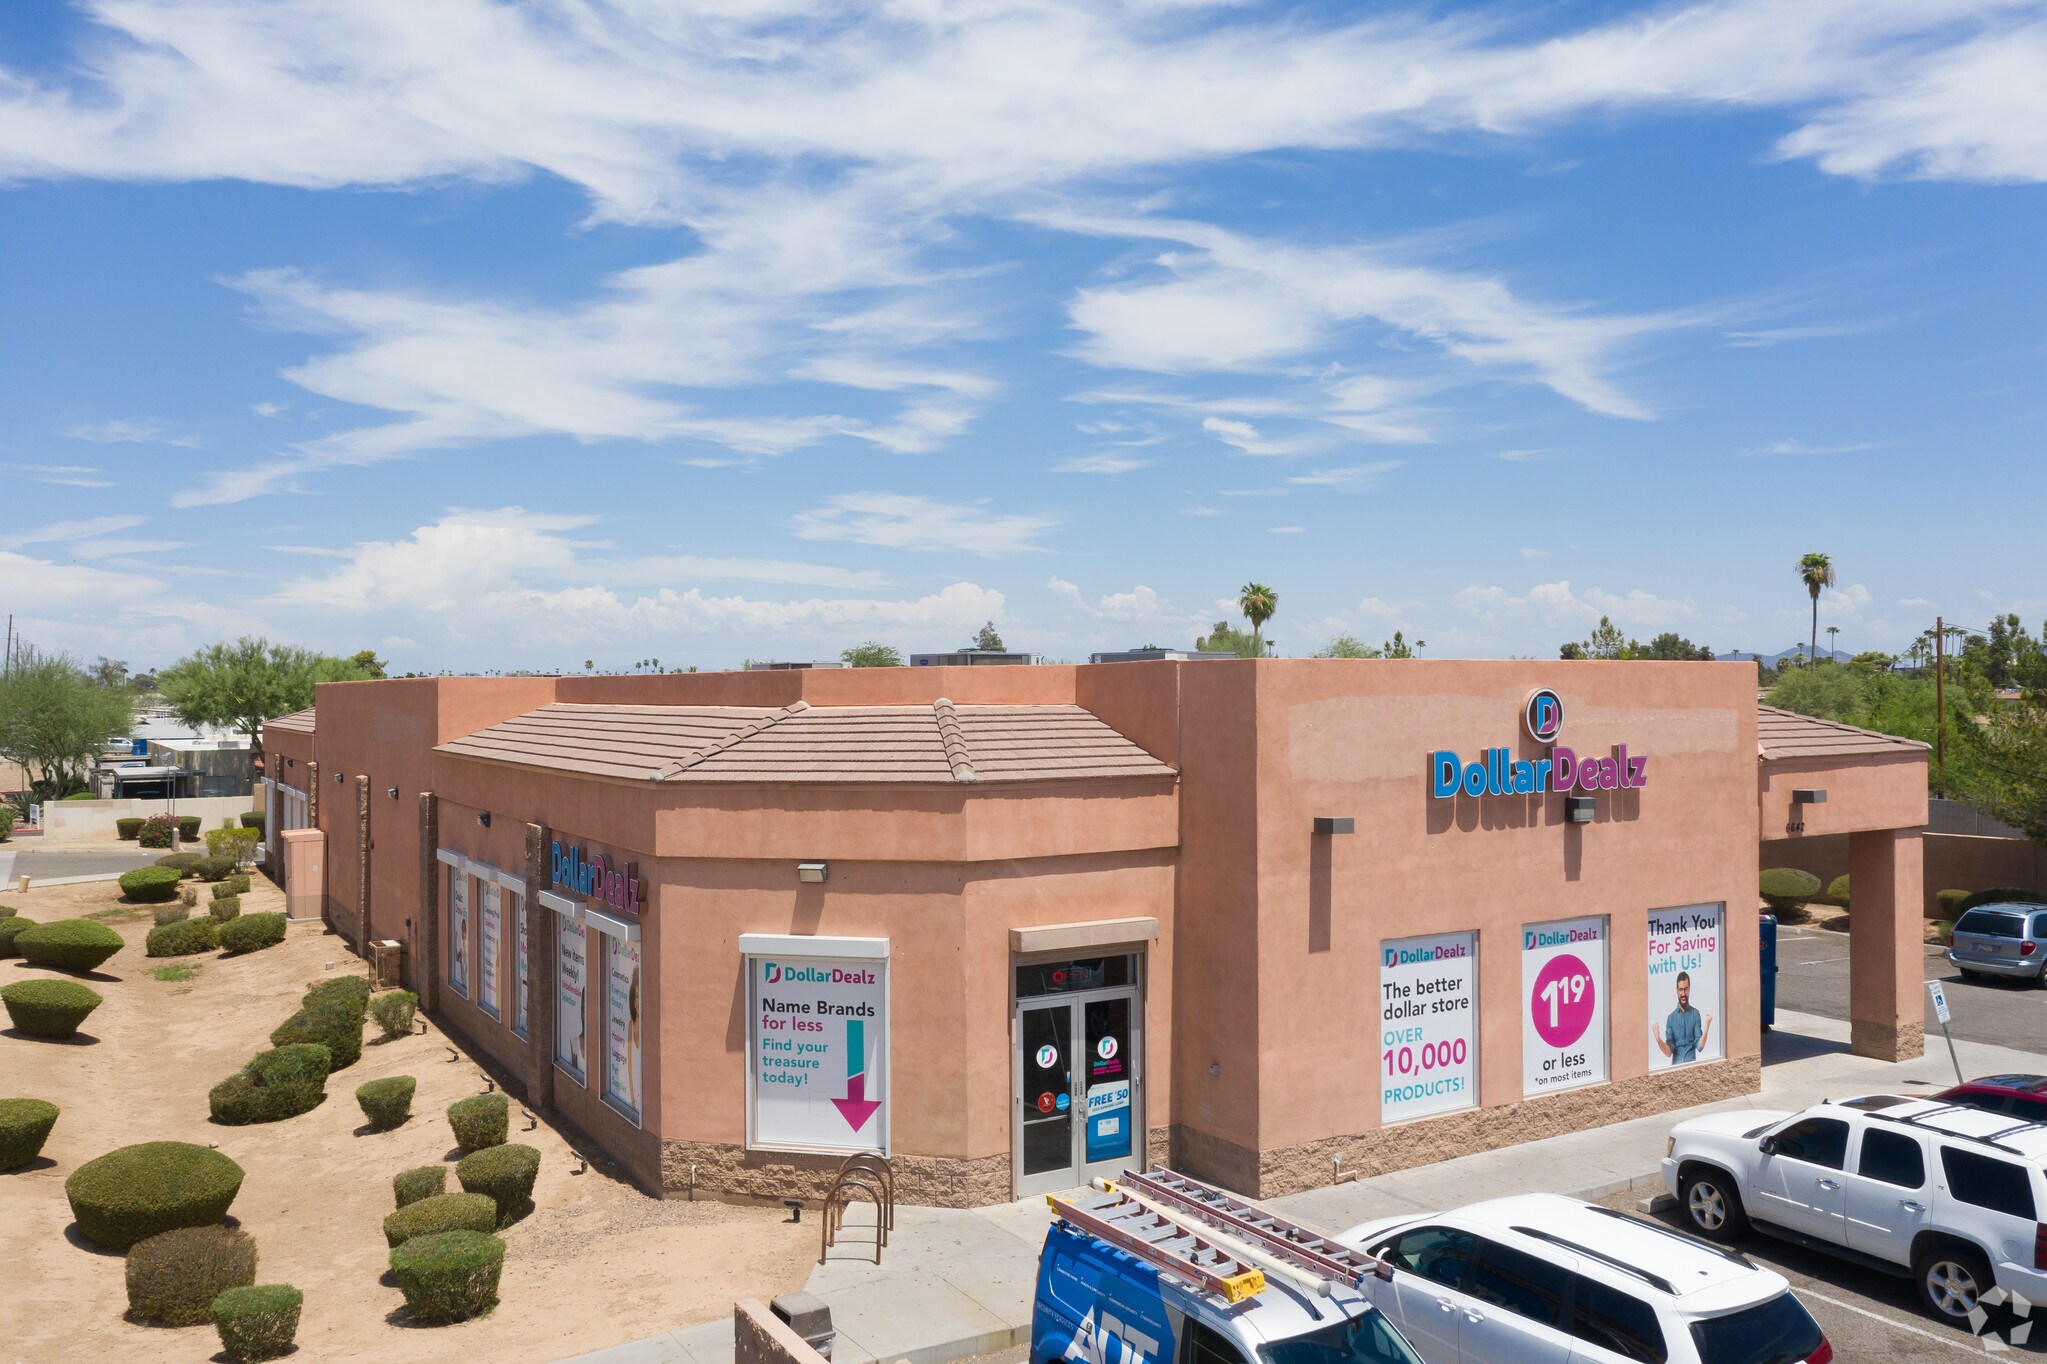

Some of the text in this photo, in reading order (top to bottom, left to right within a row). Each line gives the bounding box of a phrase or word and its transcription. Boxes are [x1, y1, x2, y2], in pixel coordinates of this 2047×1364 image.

[1433, 743, 1648, 798] DollarDealz
[552, 841, 640, 915] DollarDealz
[1648, 914, 1716, 936] Thank You
[1538, 927, 1597, 947] DollarDealz
[1649, 934, 1716, 956] For Saving
[561, 943, 572, 959] New
[1400, 944, 1466, 964] DollarDealz
[1648, 953, 1702, 975] with Us!
[611, 967, 629, 984] Cosmetics
[784, 966, 876, 985] DollarDealz
[1053, 969, 1089, 983] OPEN
[1383, 977, 1463, 1000] The better
[762, 997, 876, 1017] Name Brands
[1383, 997, 1469, 1020] dollar store
[762, 1014, 824, 1032] for less
[1383, 1027, 1423, 1046] OVER
[611, 1046, 627, 1065] Luggage
[762, 1038, 829, 1055] Find your
[762, 1055, 820, 1069] treasure
[1383, 1038, 1467, 1076] 10,000
[1543, 1052, 1585, 1071] or less
[762, 1071, 808, 1087] today!
[1550, 1072, 1570, 1084] most
[1571, 1068, 1593, 1081] items
[1384, 1076, 1465, 1104] PRODUCTS!
[1088, 1092, 1113, 1108] FREE
[1064, 1304, 1159, 1364] ADT
